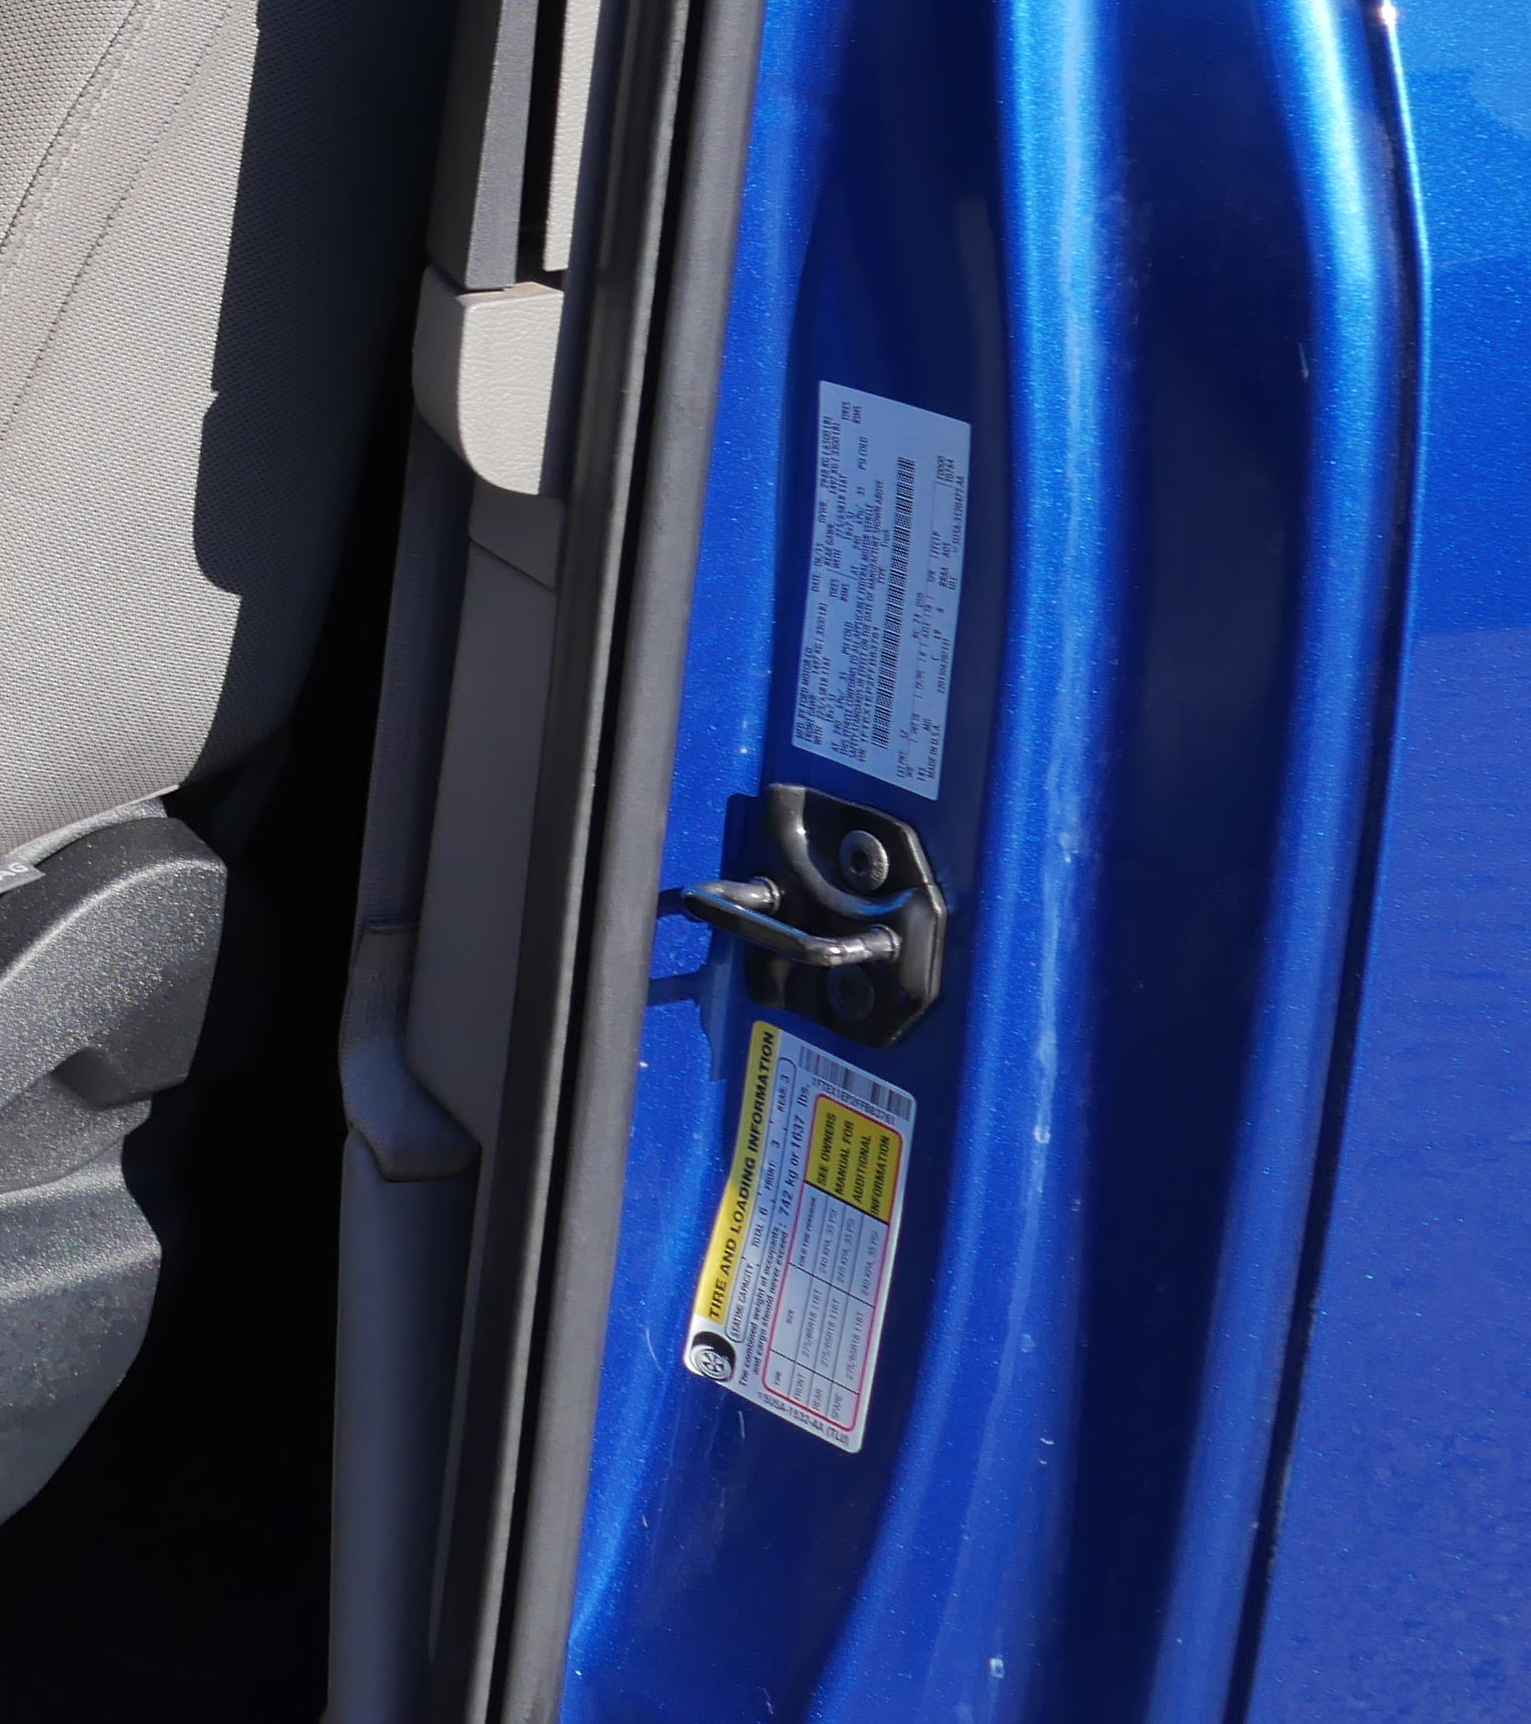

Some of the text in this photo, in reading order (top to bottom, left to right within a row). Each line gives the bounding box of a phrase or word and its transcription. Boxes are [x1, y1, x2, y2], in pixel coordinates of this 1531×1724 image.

[796, 1083, 810, 1107] lbs.
[790, 1115, 805, 1148] 1637
[789, 1152, 799, 1166] or
[817, 1112, 836, 1186] SEE OWNERS
[834, 1120, 854, 1196] MANUAL FOR
[709, 1031, 773, 1319] TIRE AND LOADING INFORMATION
[785, 1169, 798, 1187] kg
[852, 1134, 871, 1203] ADDITIONAL
[870, 1135, 890, 1215] INFORMATION
[731, 1305, 743, 1338] SEATING
[738, 1262, 753, 1303] CAPACITY
[771, 1139, 780, 1148] 3
[780, 1074, 789, 1083] 3
[779, 1189, 793, 1217] 742
[769, 1267, 779, 1294] never
[739, 1226, 779, 1387] The combined weight of occupants
[761, 1294, 773, 1327] should
[756, 1328, 767, 1356] cargo
[753, 1356, 761, 1375] and
